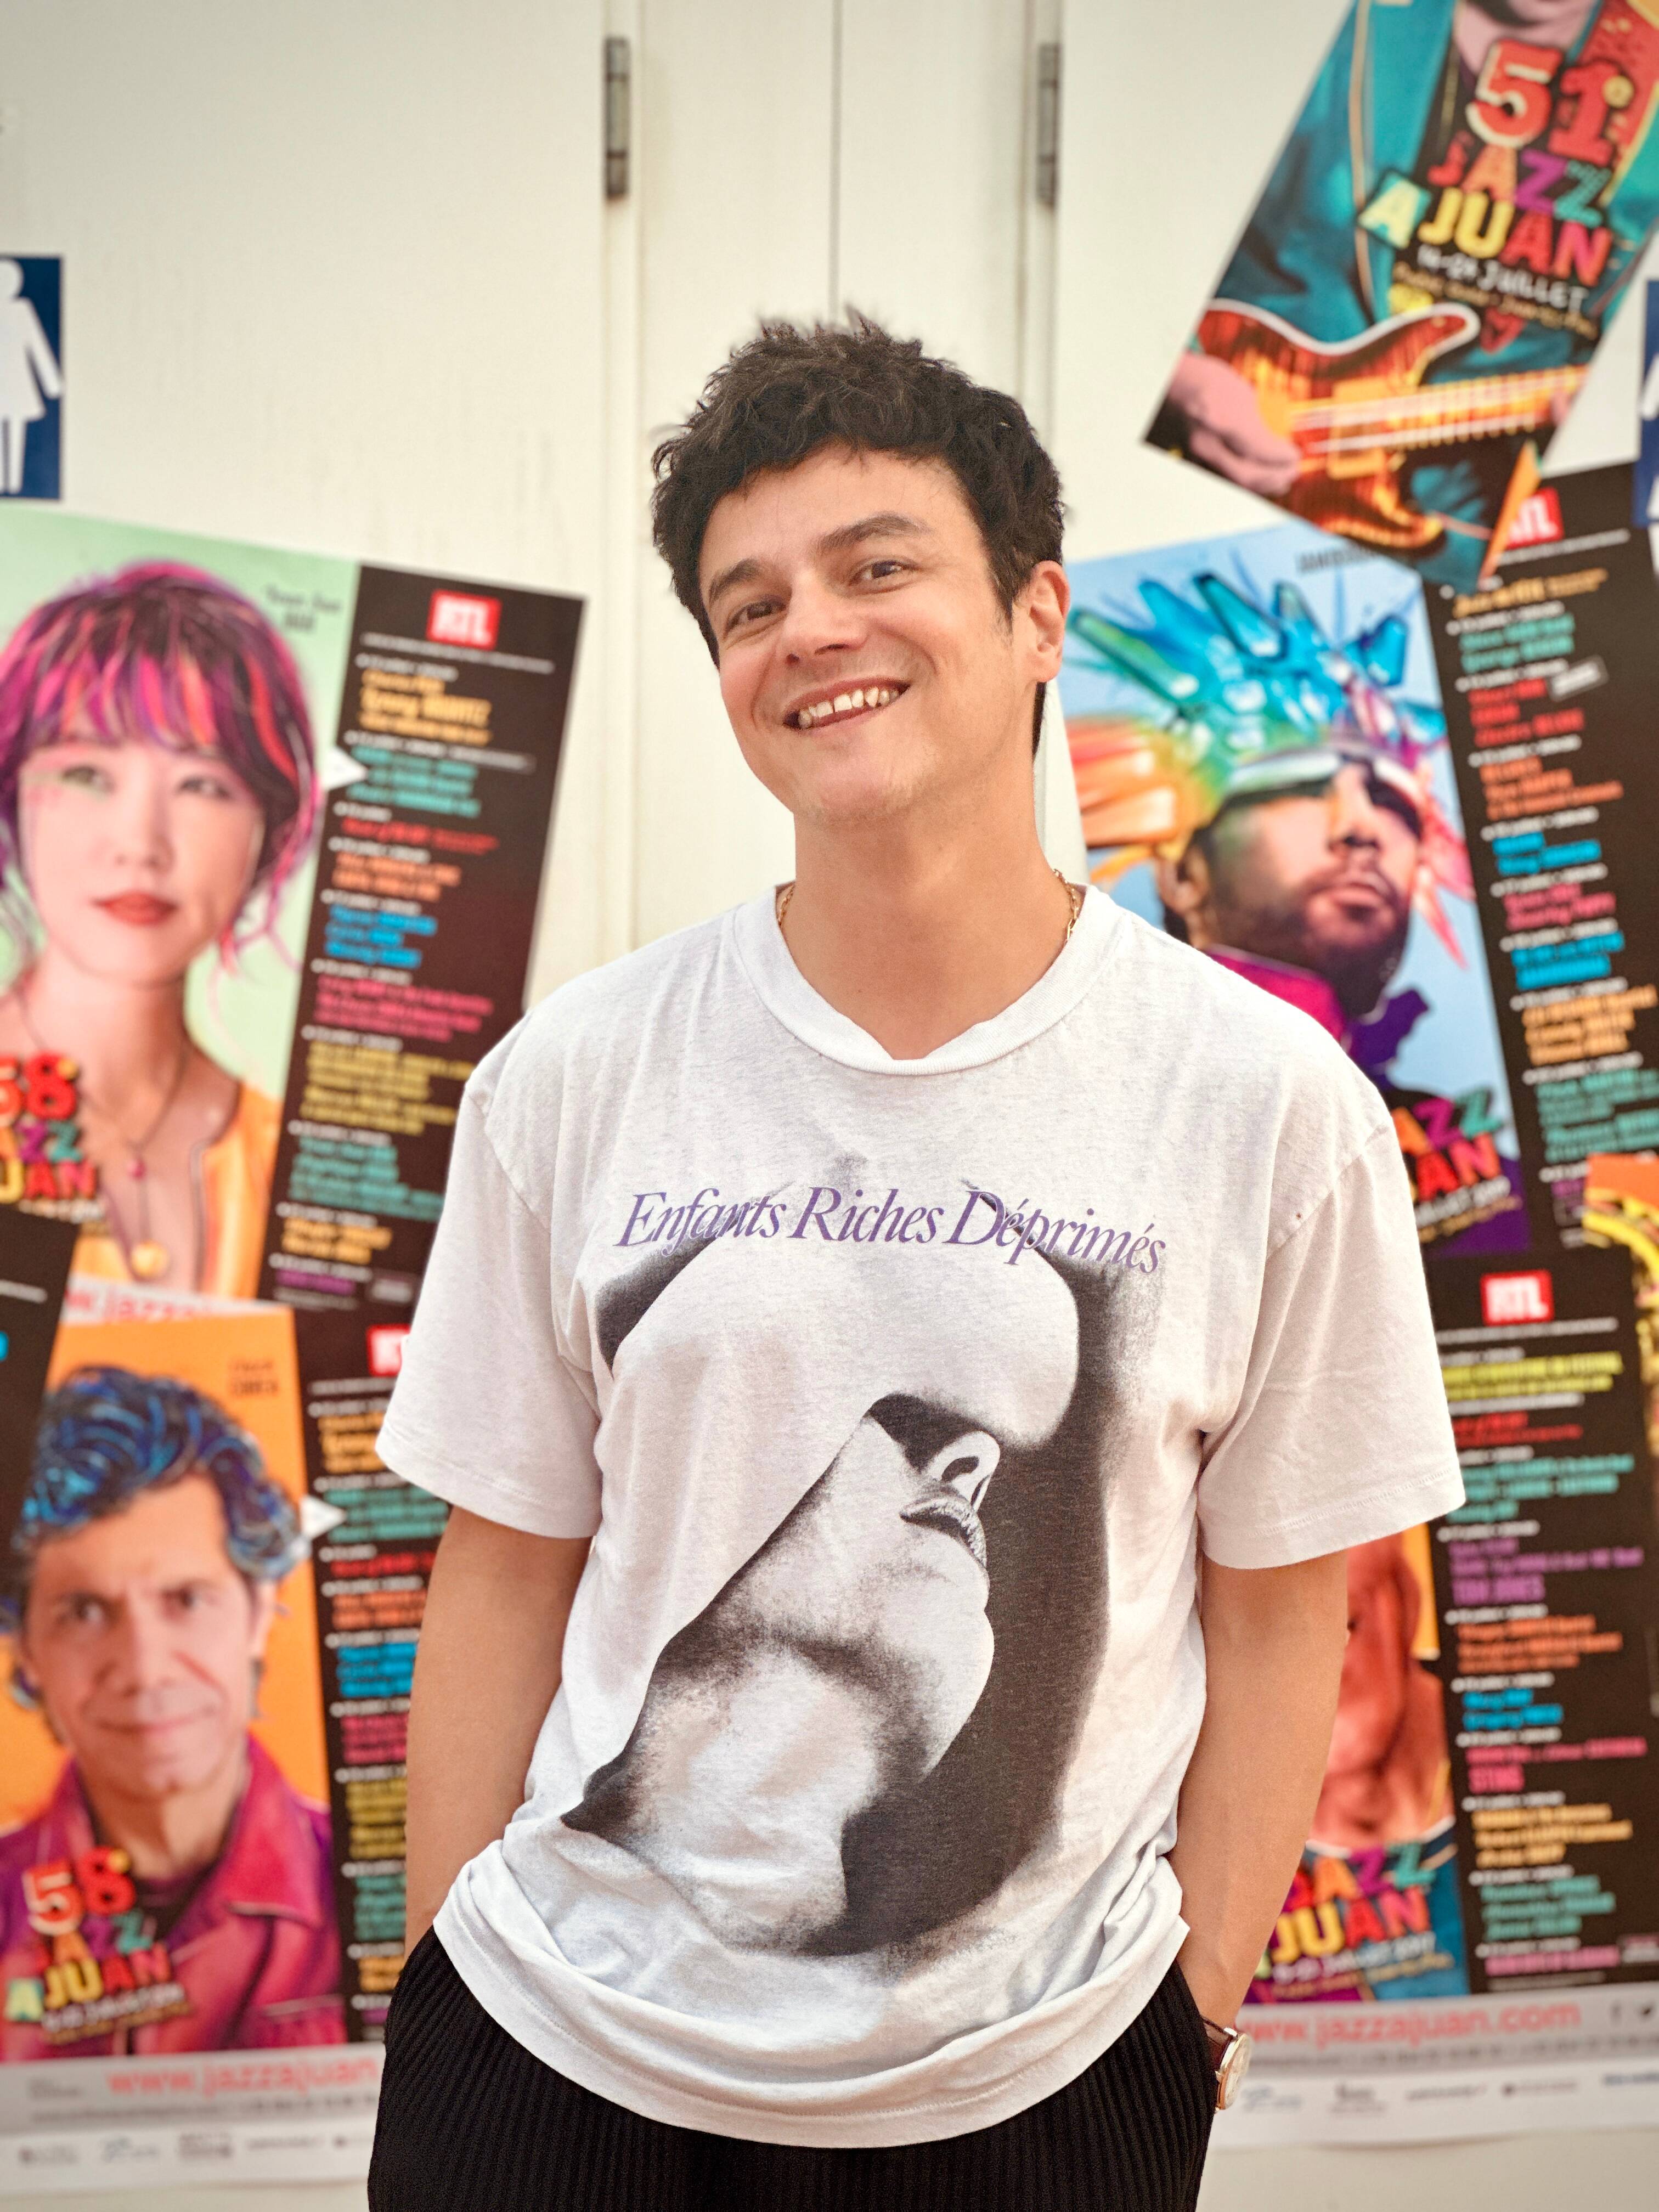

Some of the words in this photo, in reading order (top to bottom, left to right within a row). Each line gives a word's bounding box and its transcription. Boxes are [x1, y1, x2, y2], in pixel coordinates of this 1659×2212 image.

[1428, 132, 1611, 228] JAZZ
[1417, 188, 1611, 285] JUAN
[613, 1187, 787, 1257] Enfants
[787, 1186, 944, 1245] Riches
[945, 1189, 1166, 1273] Déprimés
[1483, 1276, 1550, 1323] RTL
[1272, 1884, 1430, 1965] JUAN
[44, 1941, 171, 2009] JUAN
